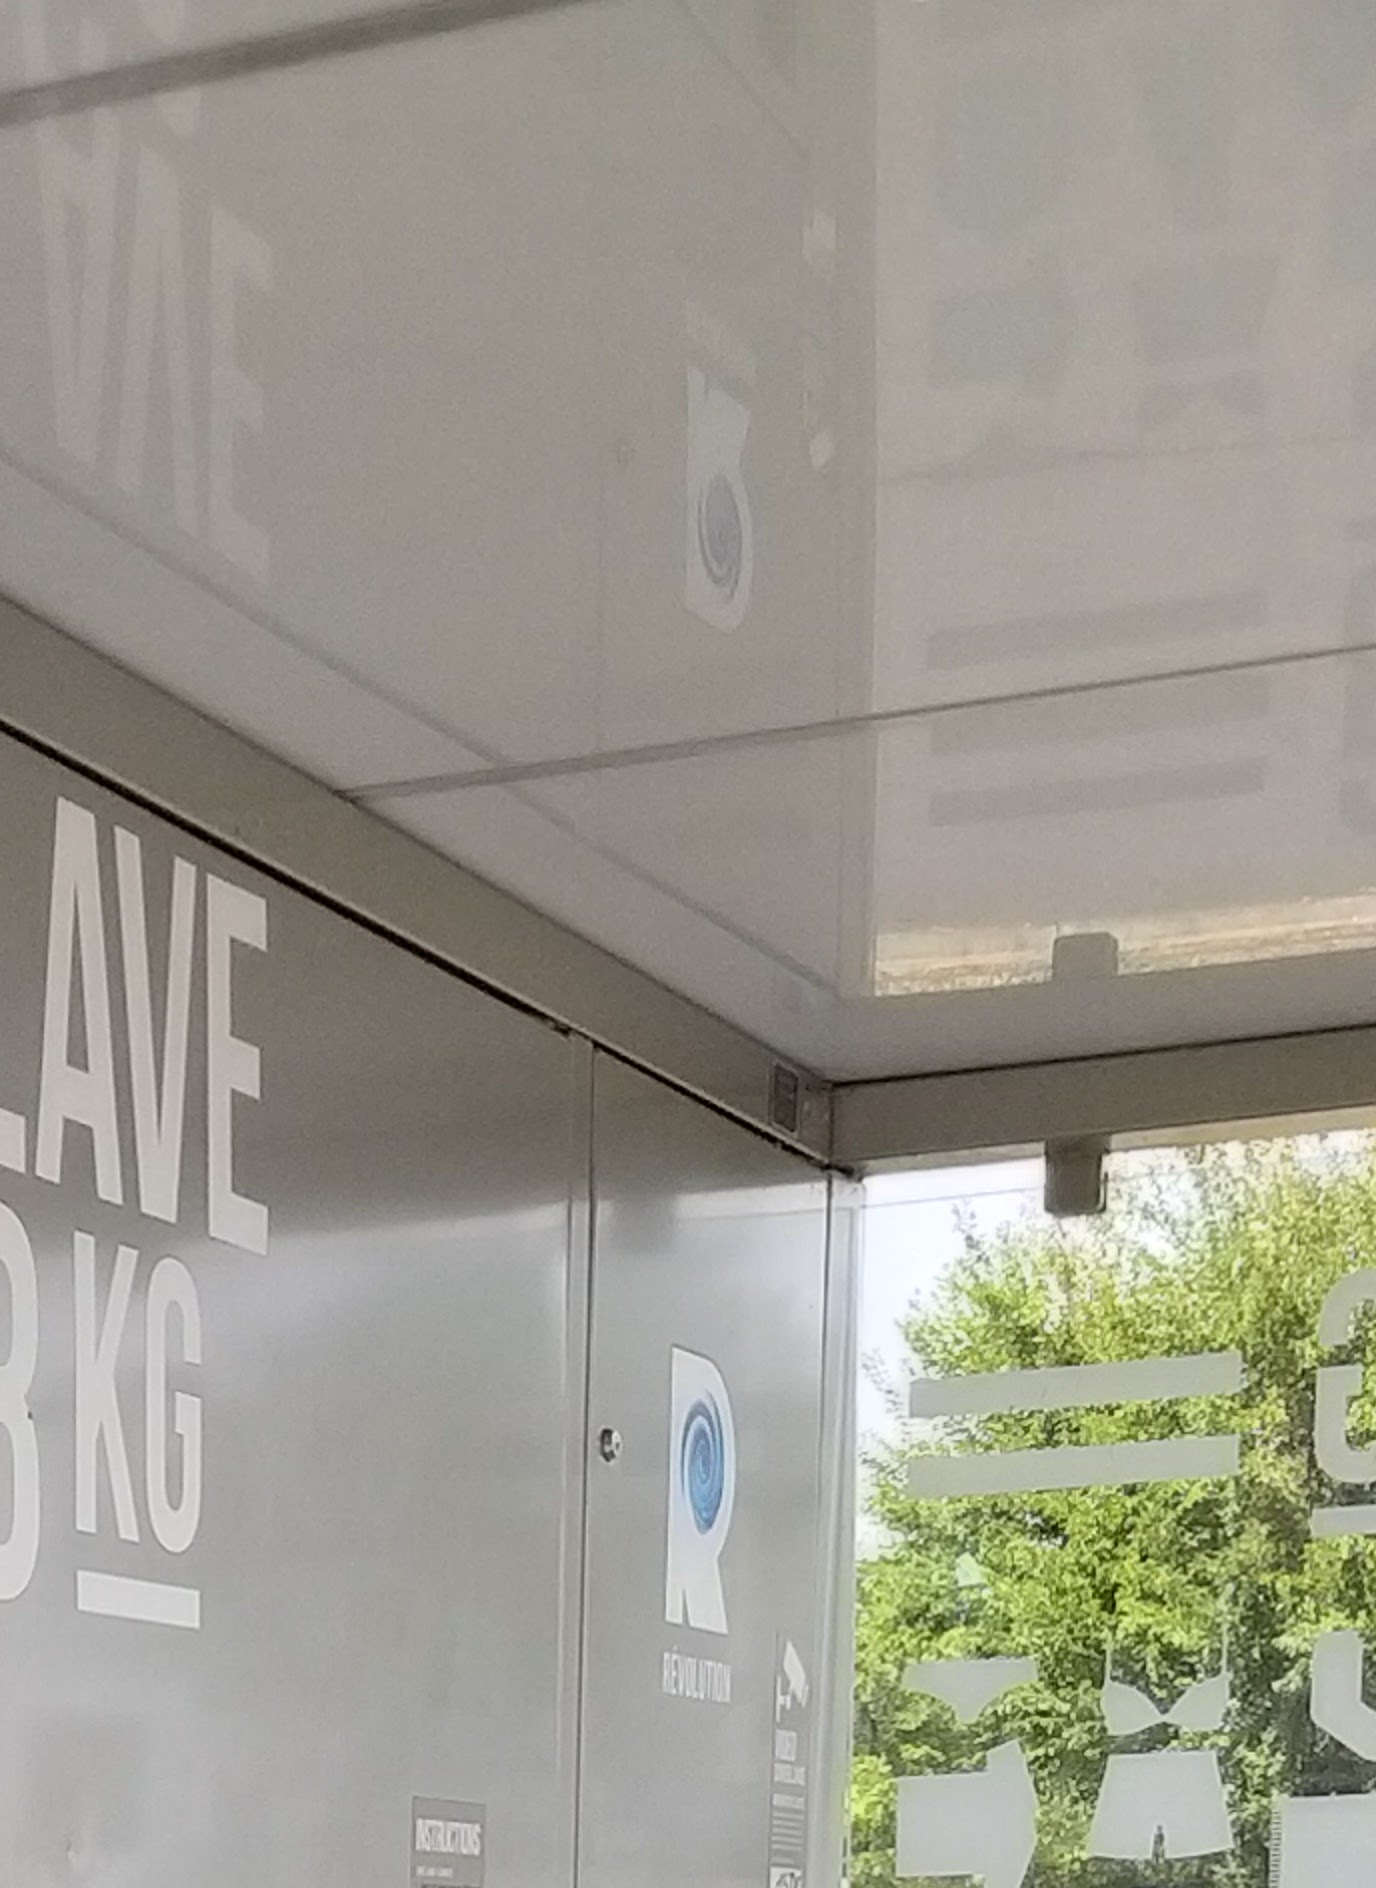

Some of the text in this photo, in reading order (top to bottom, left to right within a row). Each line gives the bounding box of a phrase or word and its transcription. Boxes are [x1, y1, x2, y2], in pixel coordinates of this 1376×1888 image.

[73, 1229, 203, 1553] KG
[663, 1645, 731, 1704] RÉVOLUTION
[415, 1817, 481, 1857] INSTRUCTIONS
